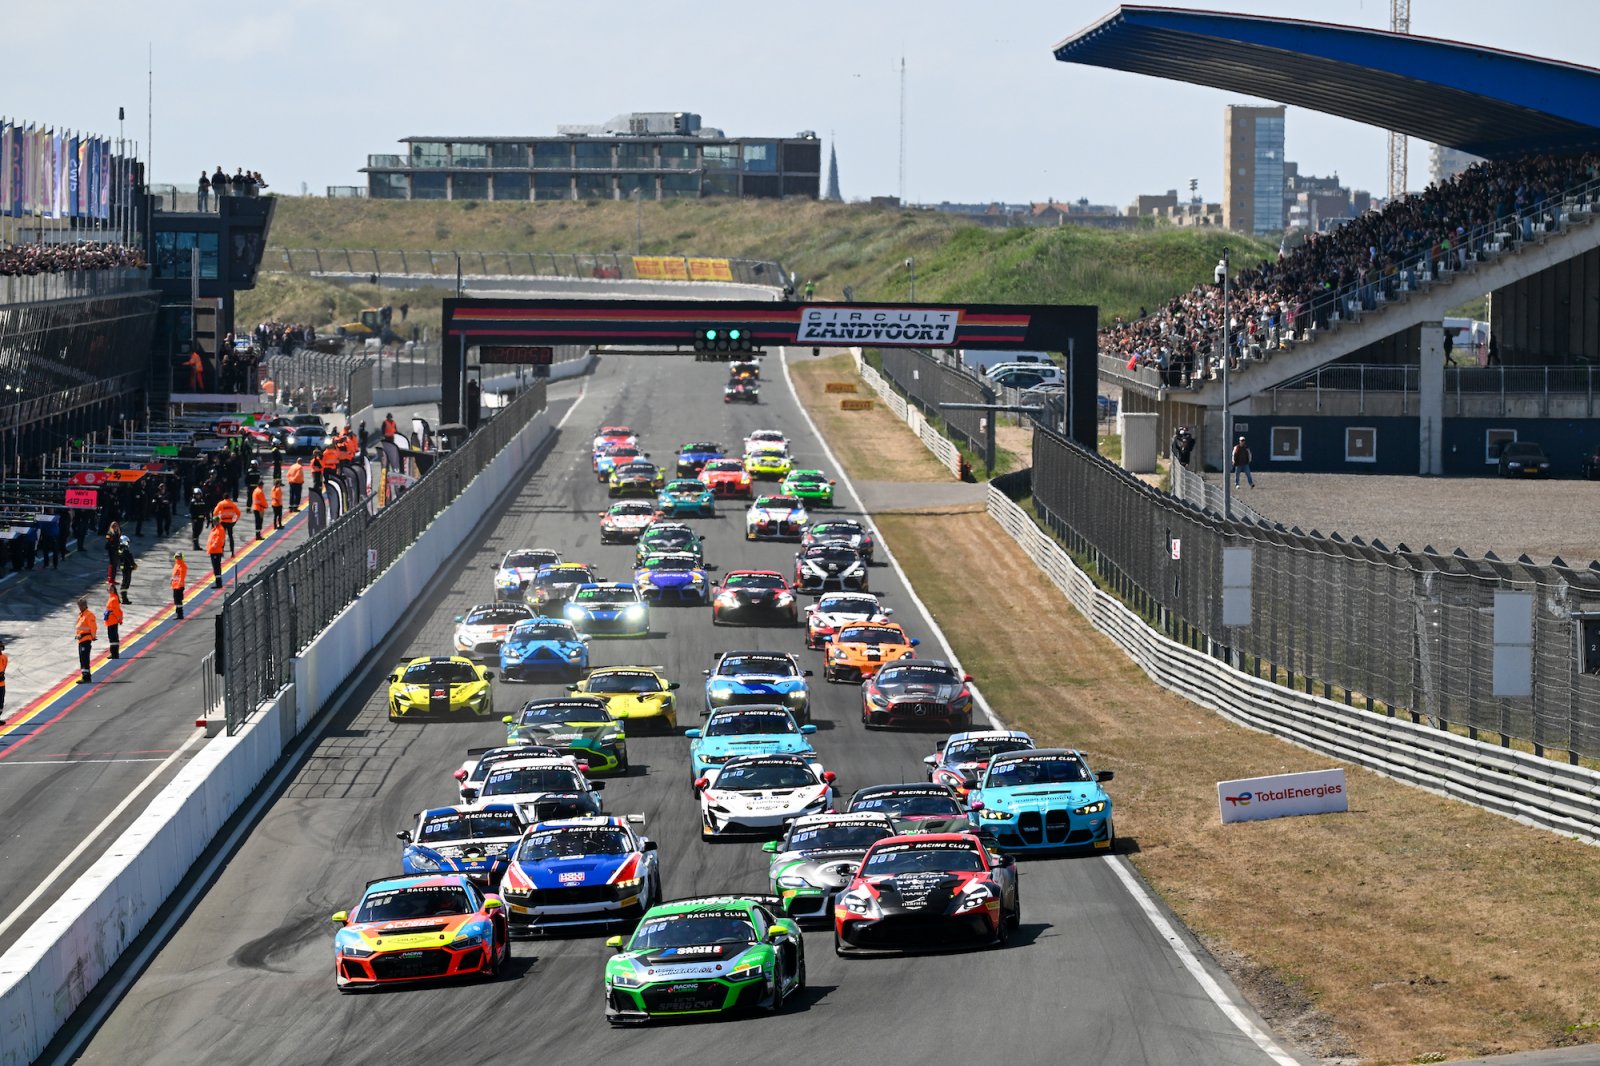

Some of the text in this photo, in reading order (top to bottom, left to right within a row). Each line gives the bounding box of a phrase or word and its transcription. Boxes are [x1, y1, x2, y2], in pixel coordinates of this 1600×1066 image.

[809, 311, 950, 322] CIRCUIT
[805, 322, 949, 341] ZANDVOORT
[1254, 784, 1342, 802] TotalEnergies
[687, 911, 721, 919] RACING
